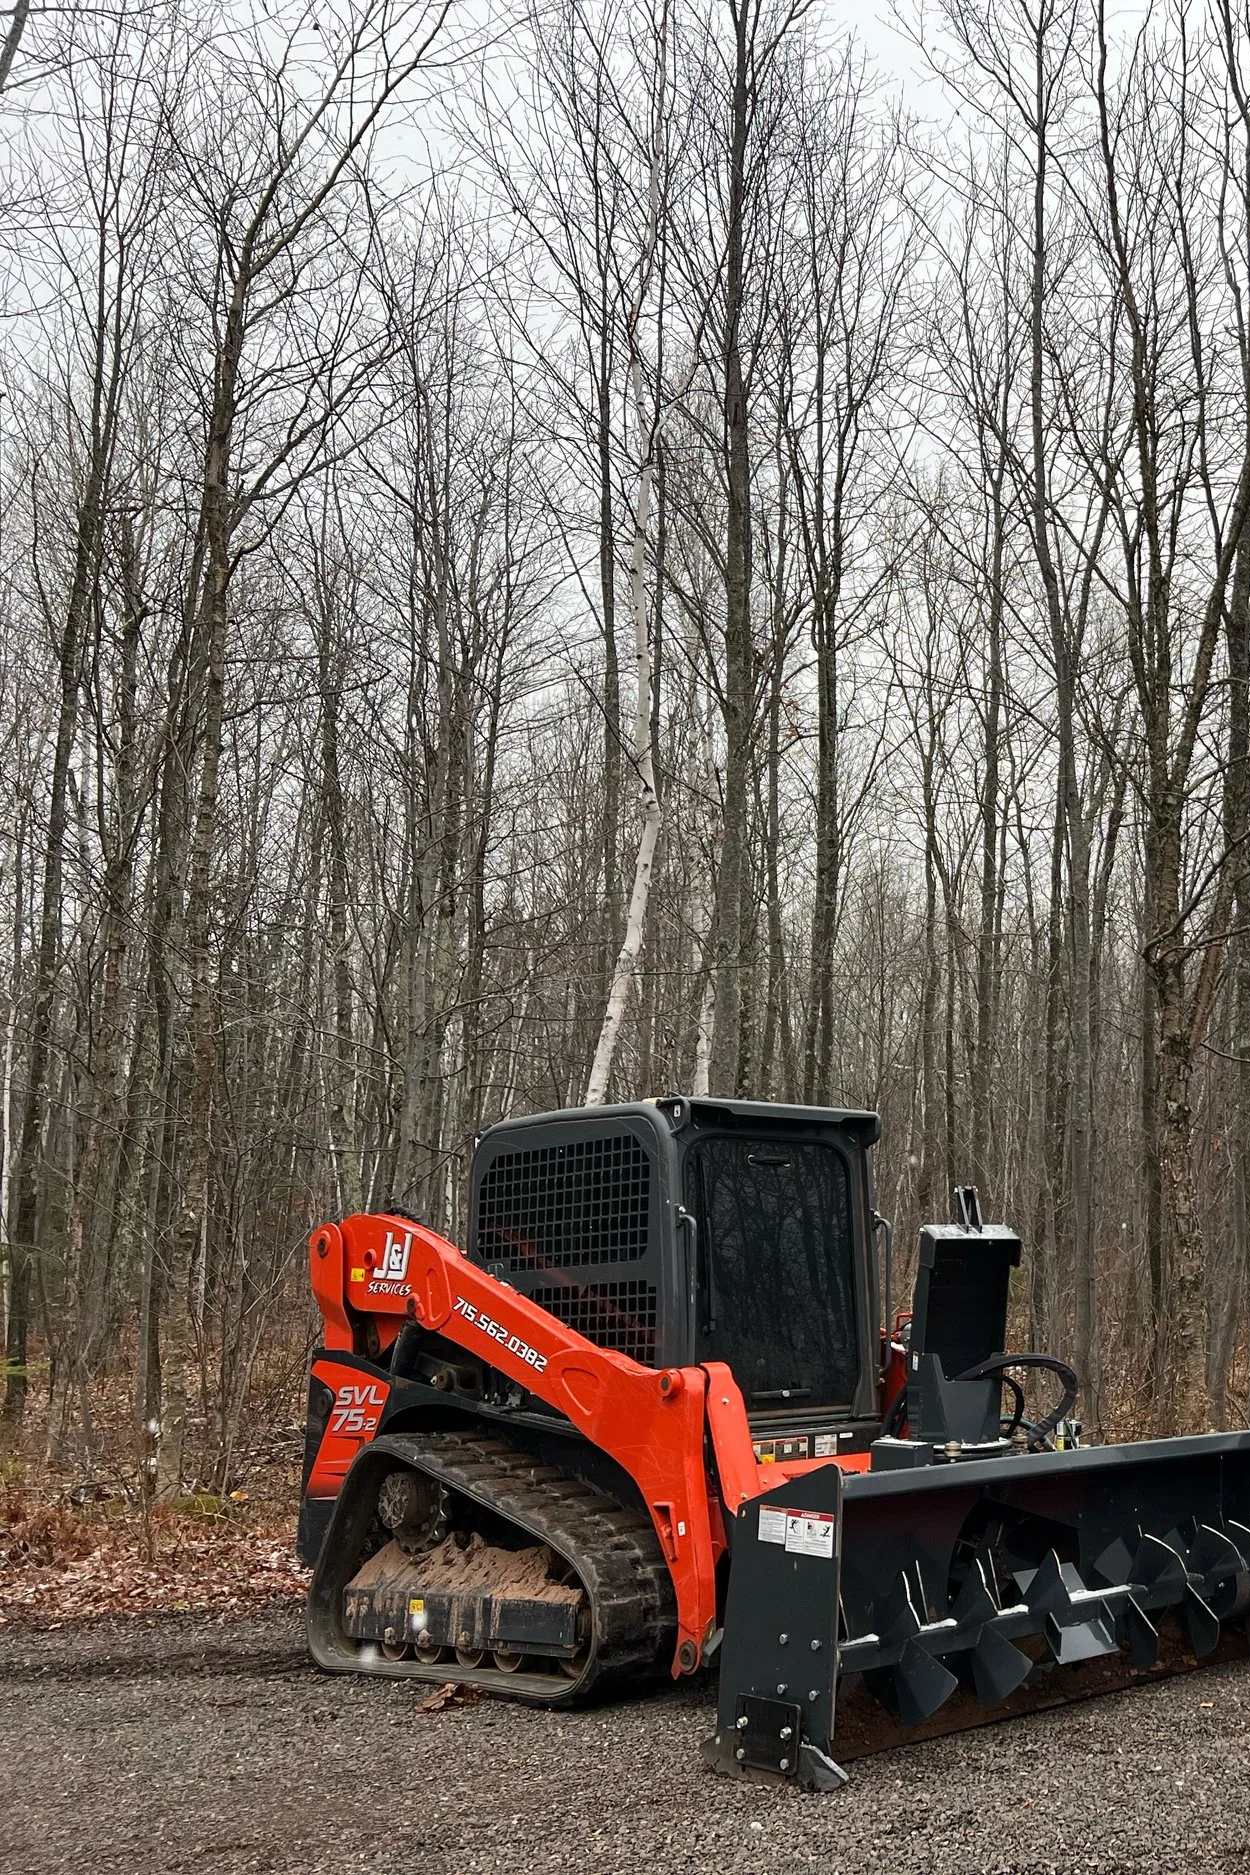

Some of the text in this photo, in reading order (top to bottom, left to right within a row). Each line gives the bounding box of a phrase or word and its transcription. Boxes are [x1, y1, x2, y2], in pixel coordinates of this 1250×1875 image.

[373, 1231, 413, 1280] J&J
[367, 1281, 412, 1296] SERVICES
[452, 1296, 548, 1373] 715.562.0382
[335, 1384, 384, 1406] SVL
[331, 1408, 377, 1432] 75-2
